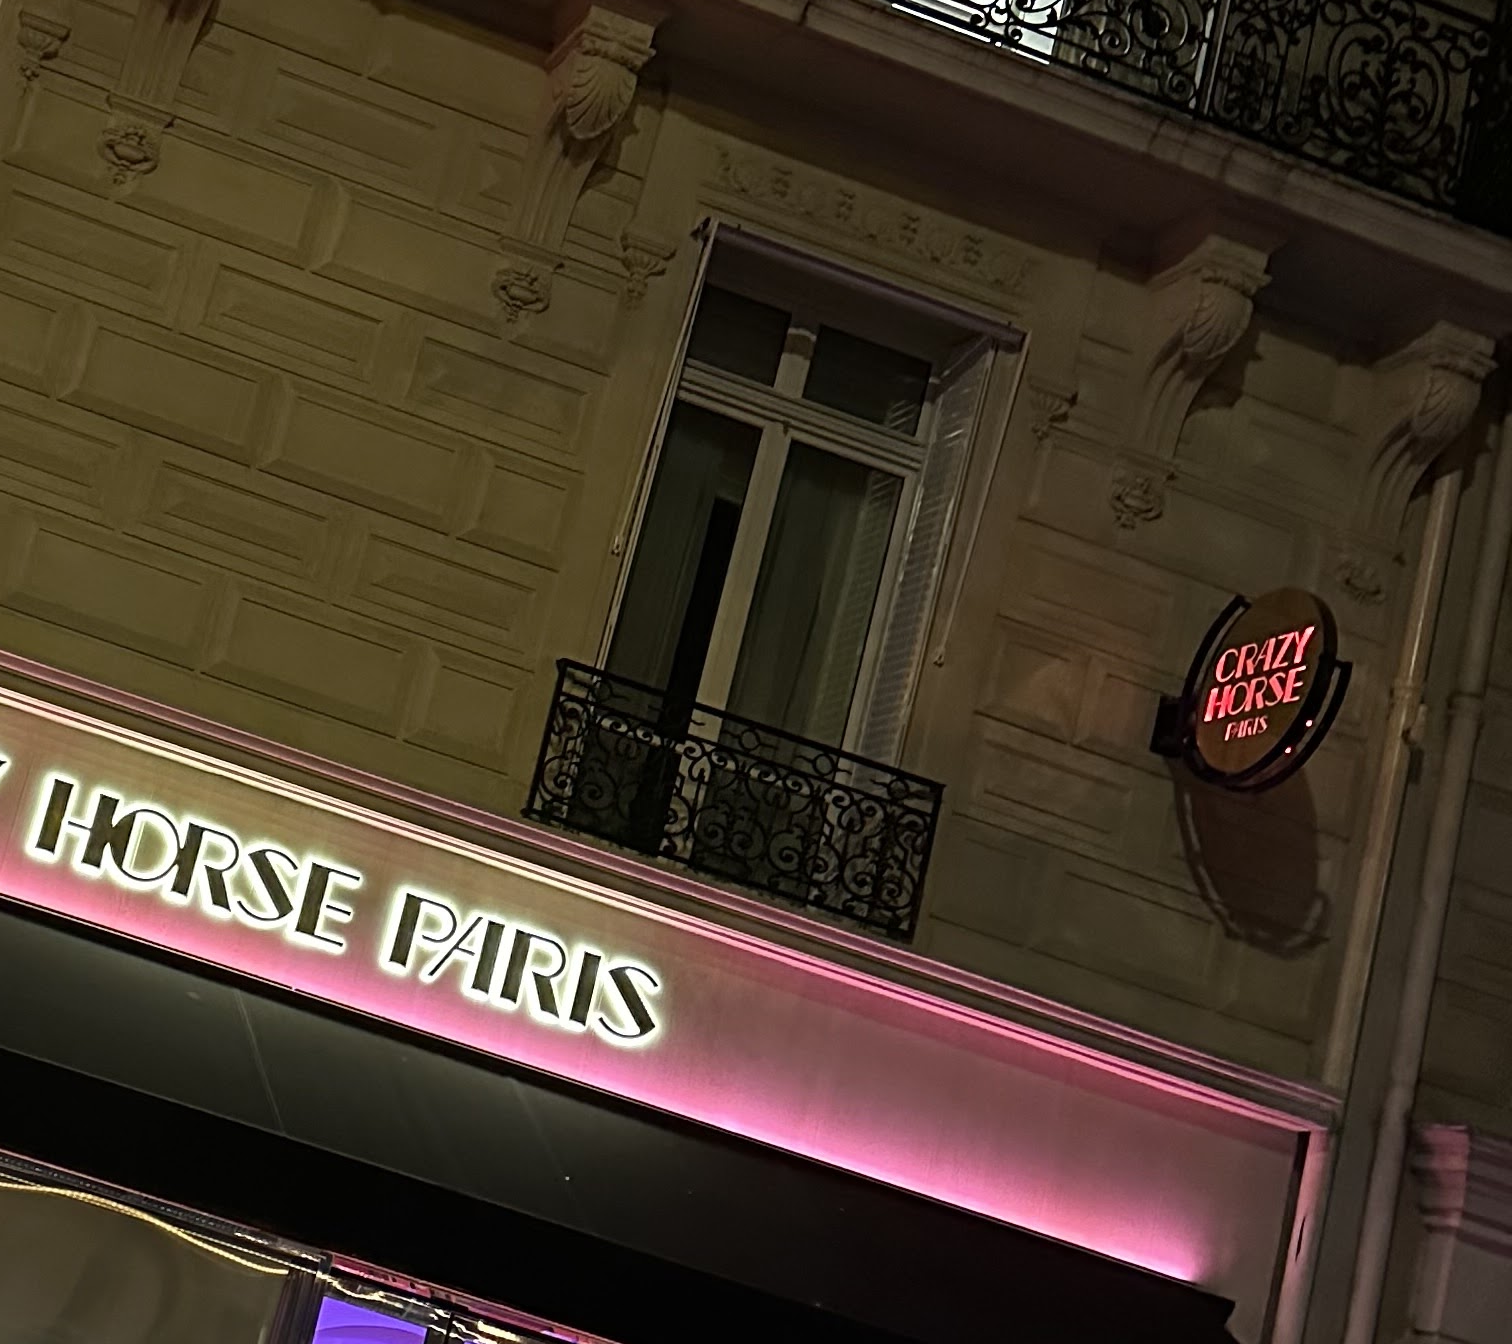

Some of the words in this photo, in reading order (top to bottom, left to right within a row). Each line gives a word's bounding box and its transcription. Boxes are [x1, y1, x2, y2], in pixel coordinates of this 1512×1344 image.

[1215, 625, 1315, 683] CRAZY
[1203, 665, 1307, 722] HORSE
[1224, 715, 1268, 741] PARIS
[33, 777, 362, 949] HORSE
[387, 891, 660, 1040] PARIS
